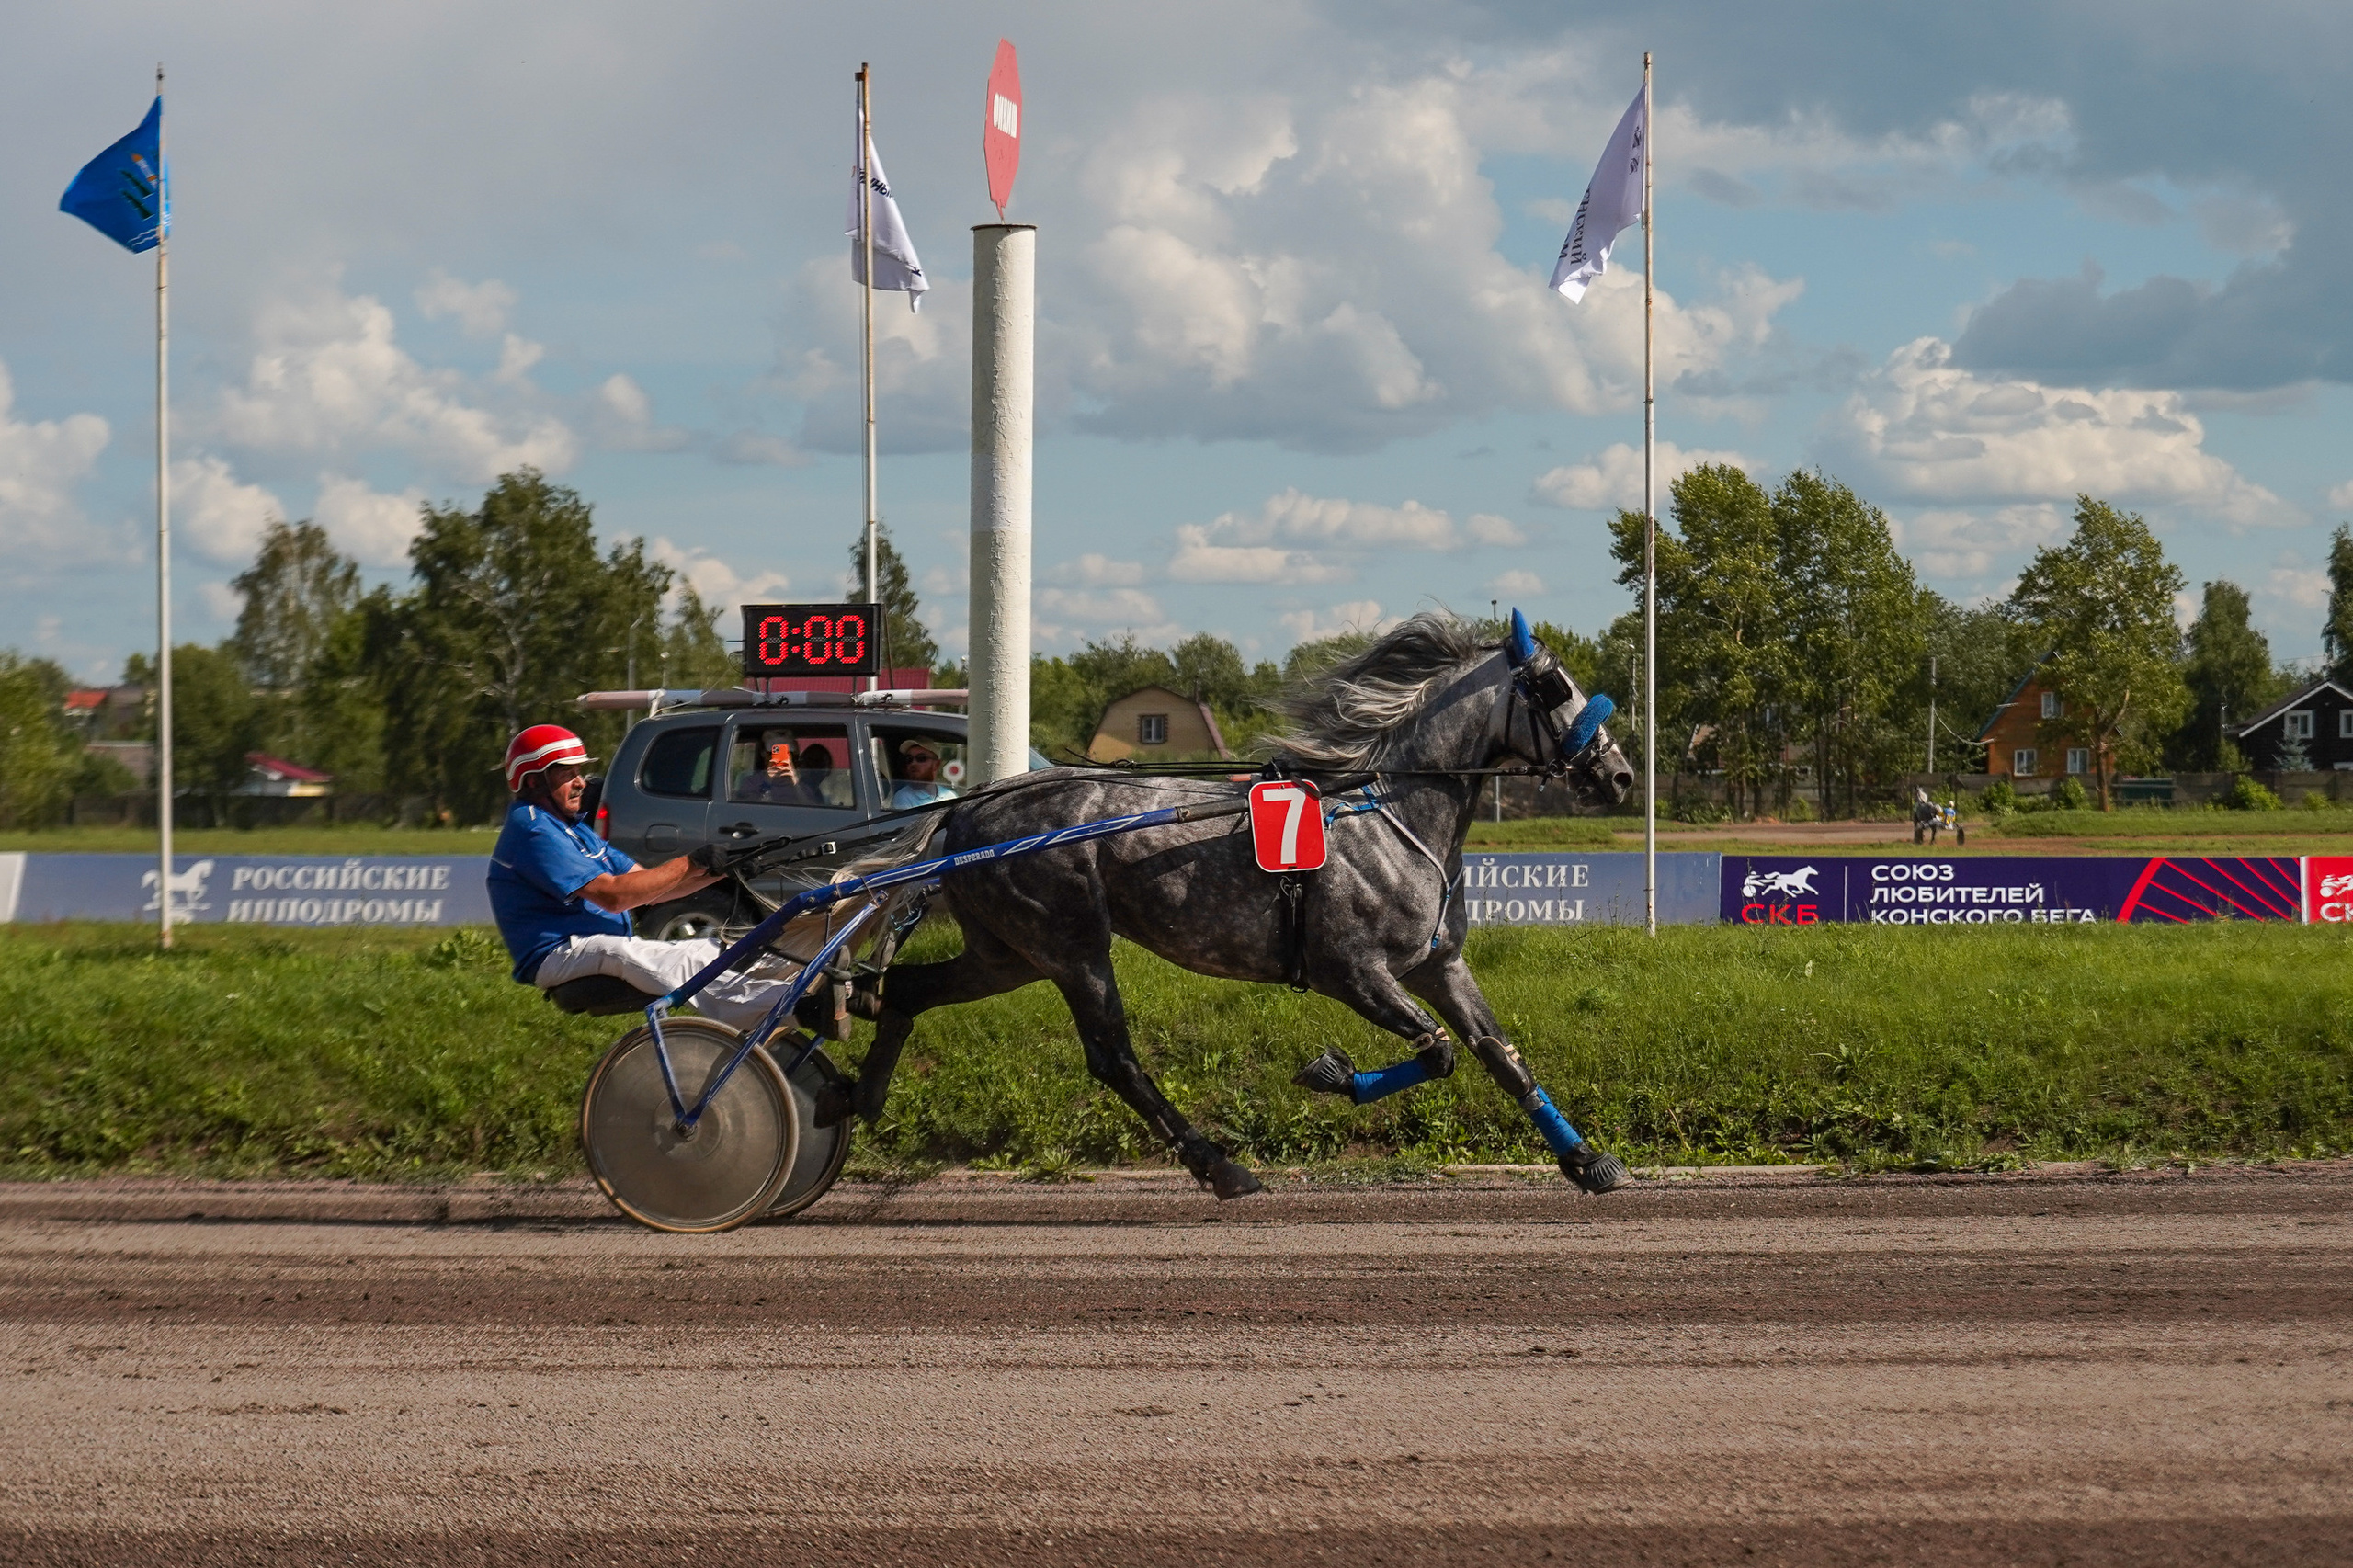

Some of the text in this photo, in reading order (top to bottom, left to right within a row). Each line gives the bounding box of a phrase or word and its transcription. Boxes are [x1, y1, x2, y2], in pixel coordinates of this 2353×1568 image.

[759, 615, 865, 665] 0:00
[1262, 787, 1306, 865] 7
[953, 849, 995, 866] DESPERADO
[232, 858, 451, 891] РОССИЙСКИЕ
[1871, 864, 1955, 881] СОЮЗ
[1870, 882, 2045, 903] ЛЮБИТЕЛЕЙ
[227, 897, 444, 926] ИППОДРОМЫ
[1741, 903, 1820, 926] СКБ
[1871, 908, 2097, 925] КОНСКОГО БЕГА
